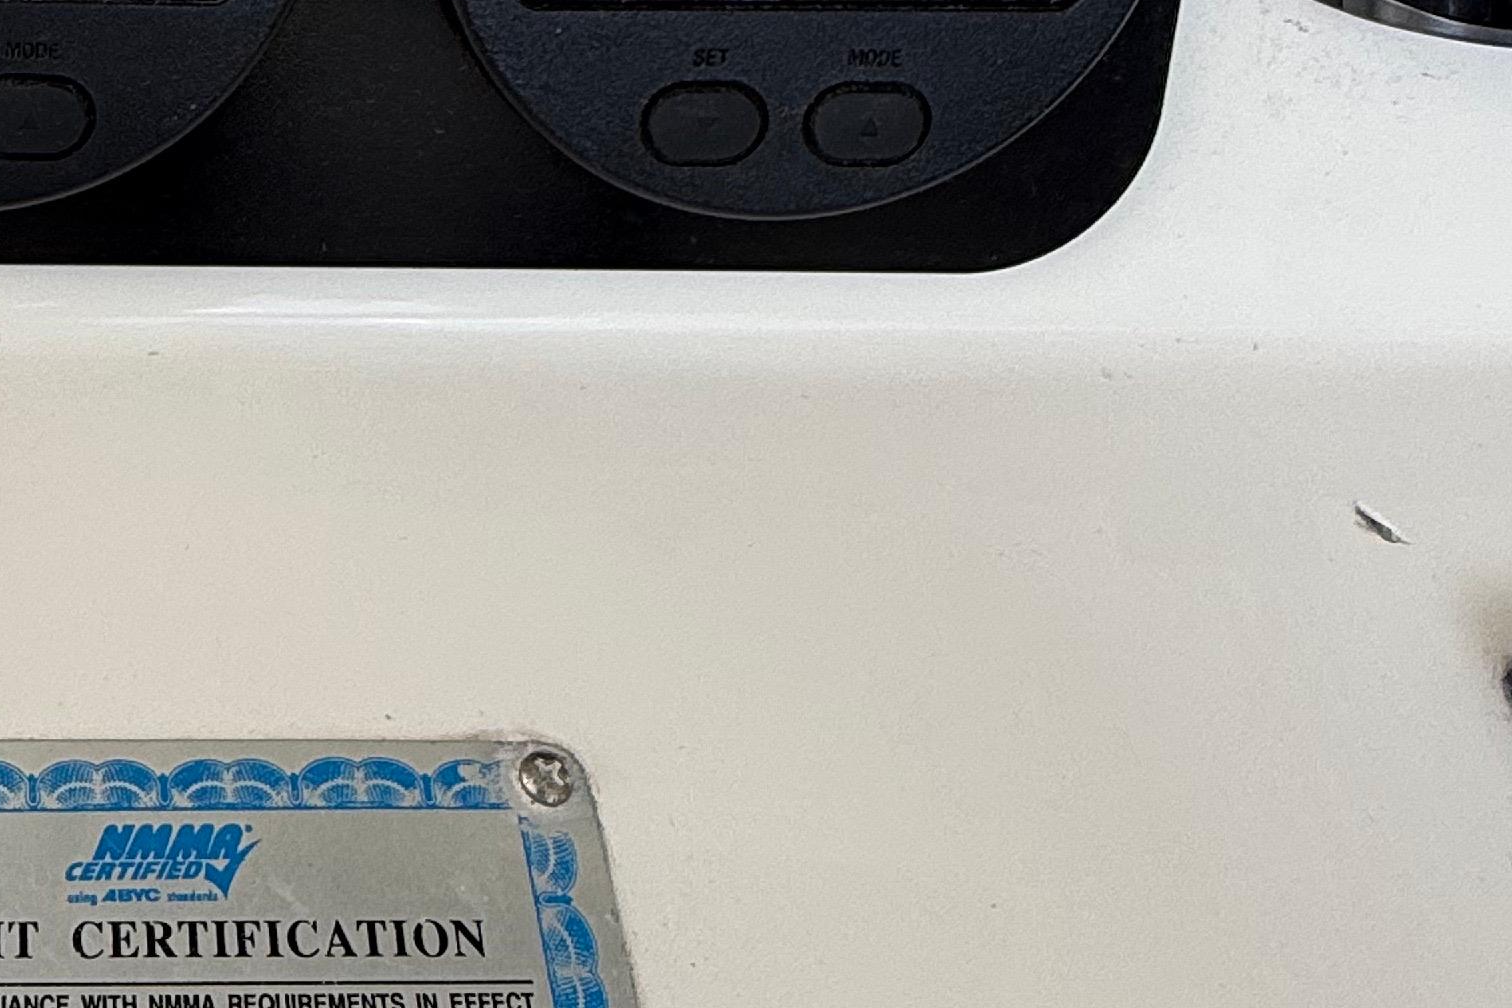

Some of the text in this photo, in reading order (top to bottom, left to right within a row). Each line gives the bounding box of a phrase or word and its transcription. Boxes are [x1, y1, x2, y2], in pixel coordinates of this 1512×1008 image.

[5, 41, 60, 60] MODE
[692, 48, 730, 67] SET
[847, 48, 903, 68] MODE
[92, 823, 244, 861] NMMA
[65, 860, 204, 882] CERTIFIED
[102, 888, 162, 903] ABYC
[73, 919, 486, 961] CERTIFICATION
[80, 993, 138, 1008] WITH
[148, 993, 214, 1008] NMMA
[416, 992, 438, 1008] IN
